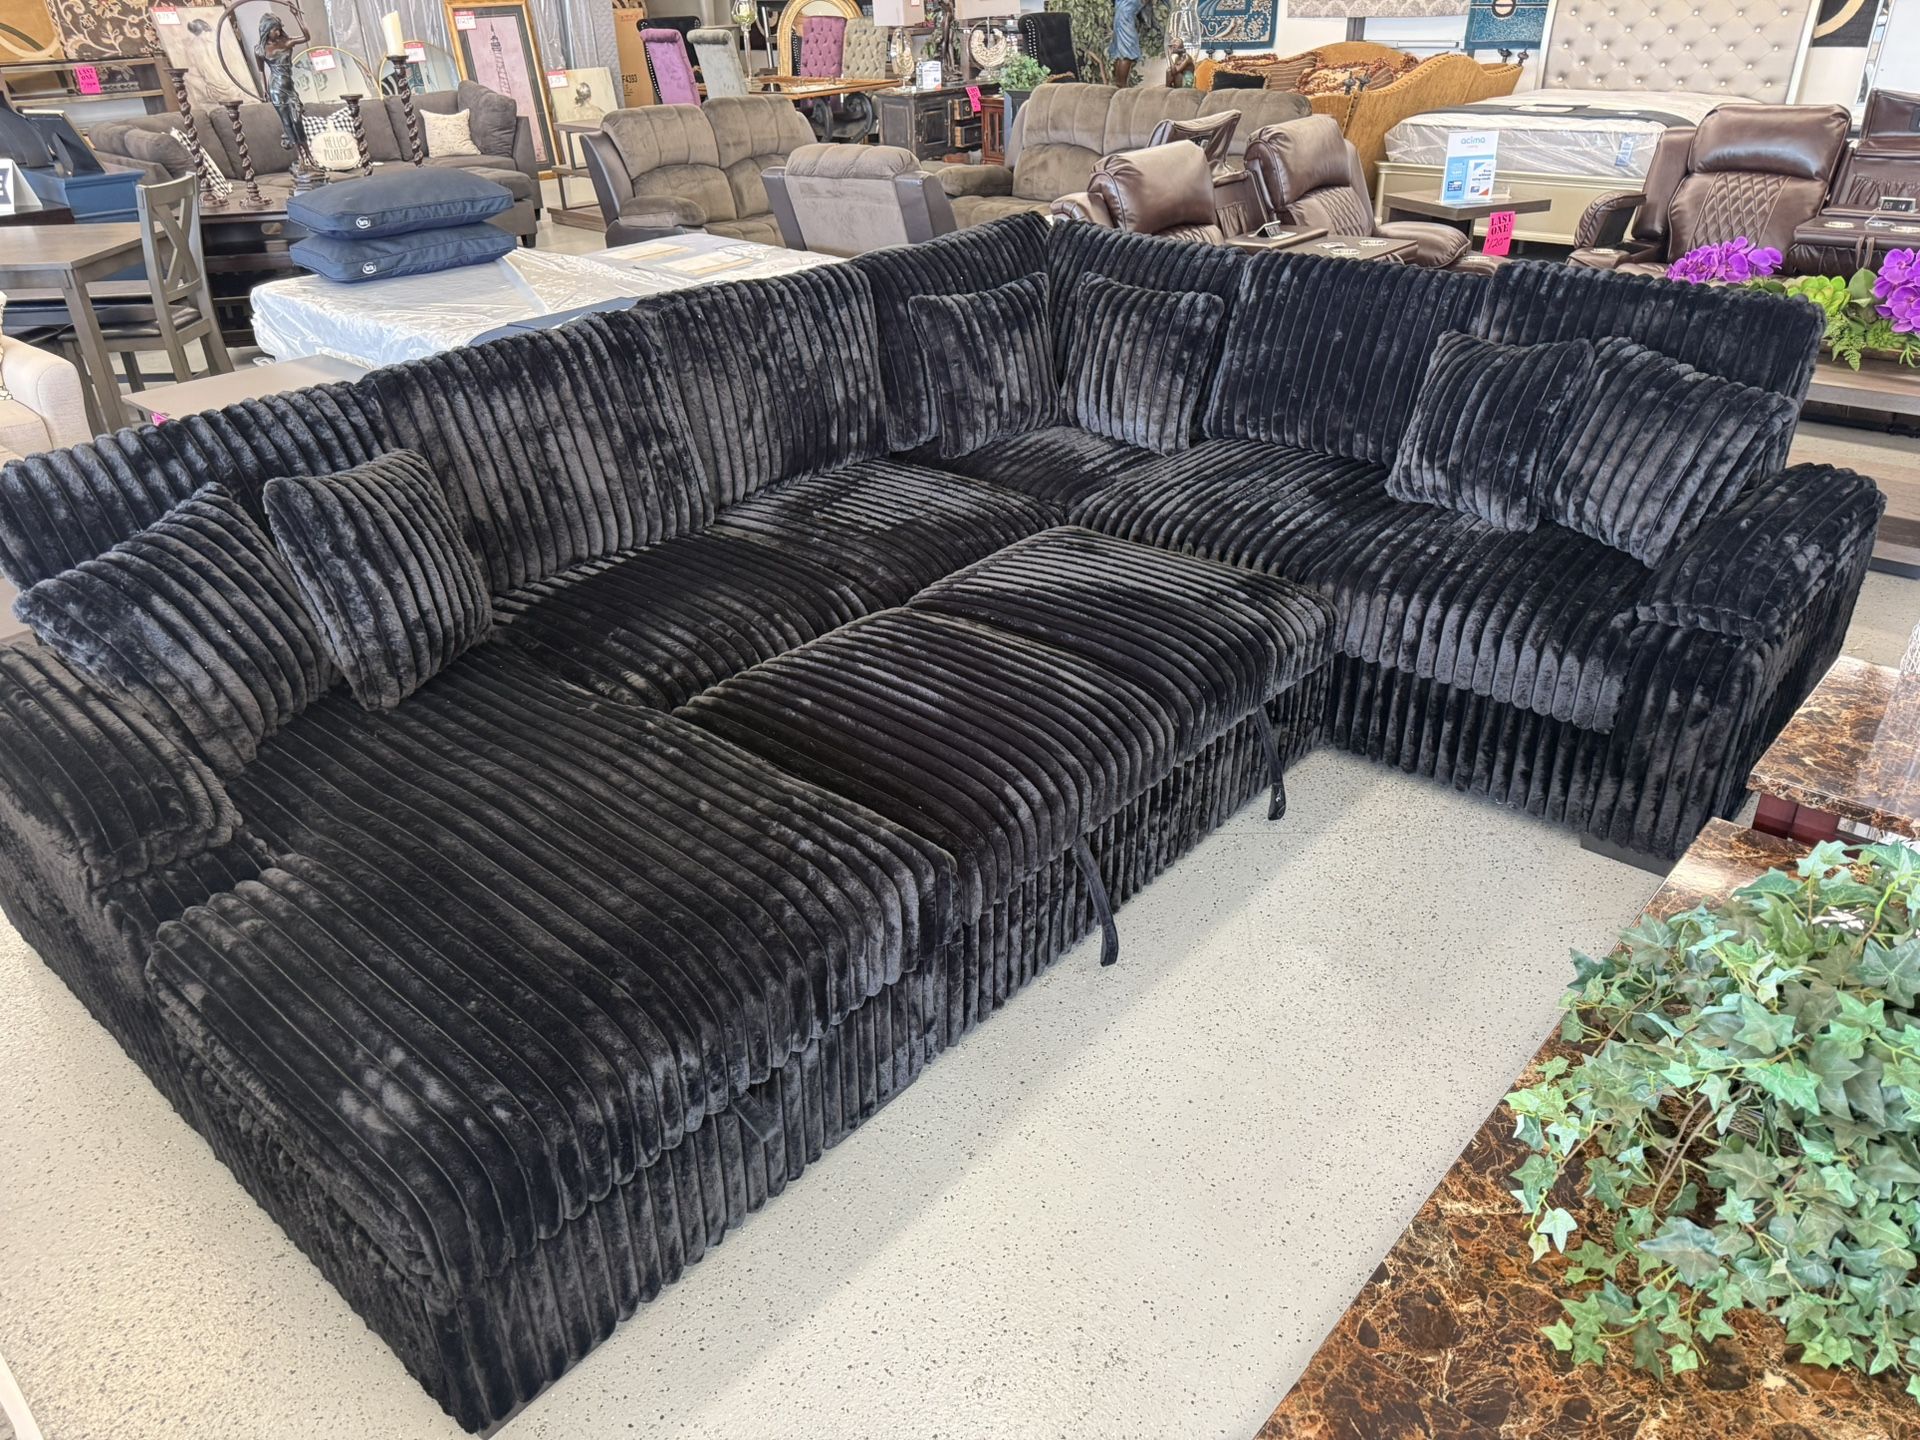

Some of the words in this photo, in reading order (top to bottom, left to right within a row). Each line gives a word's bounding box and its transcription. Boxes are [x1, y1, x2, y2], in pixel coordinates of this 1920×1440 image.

[1460, 136, 1486, 145] acima
[1491, 214, 1512, 226] LAST
[1491, 224, 1509, 235] ONE
